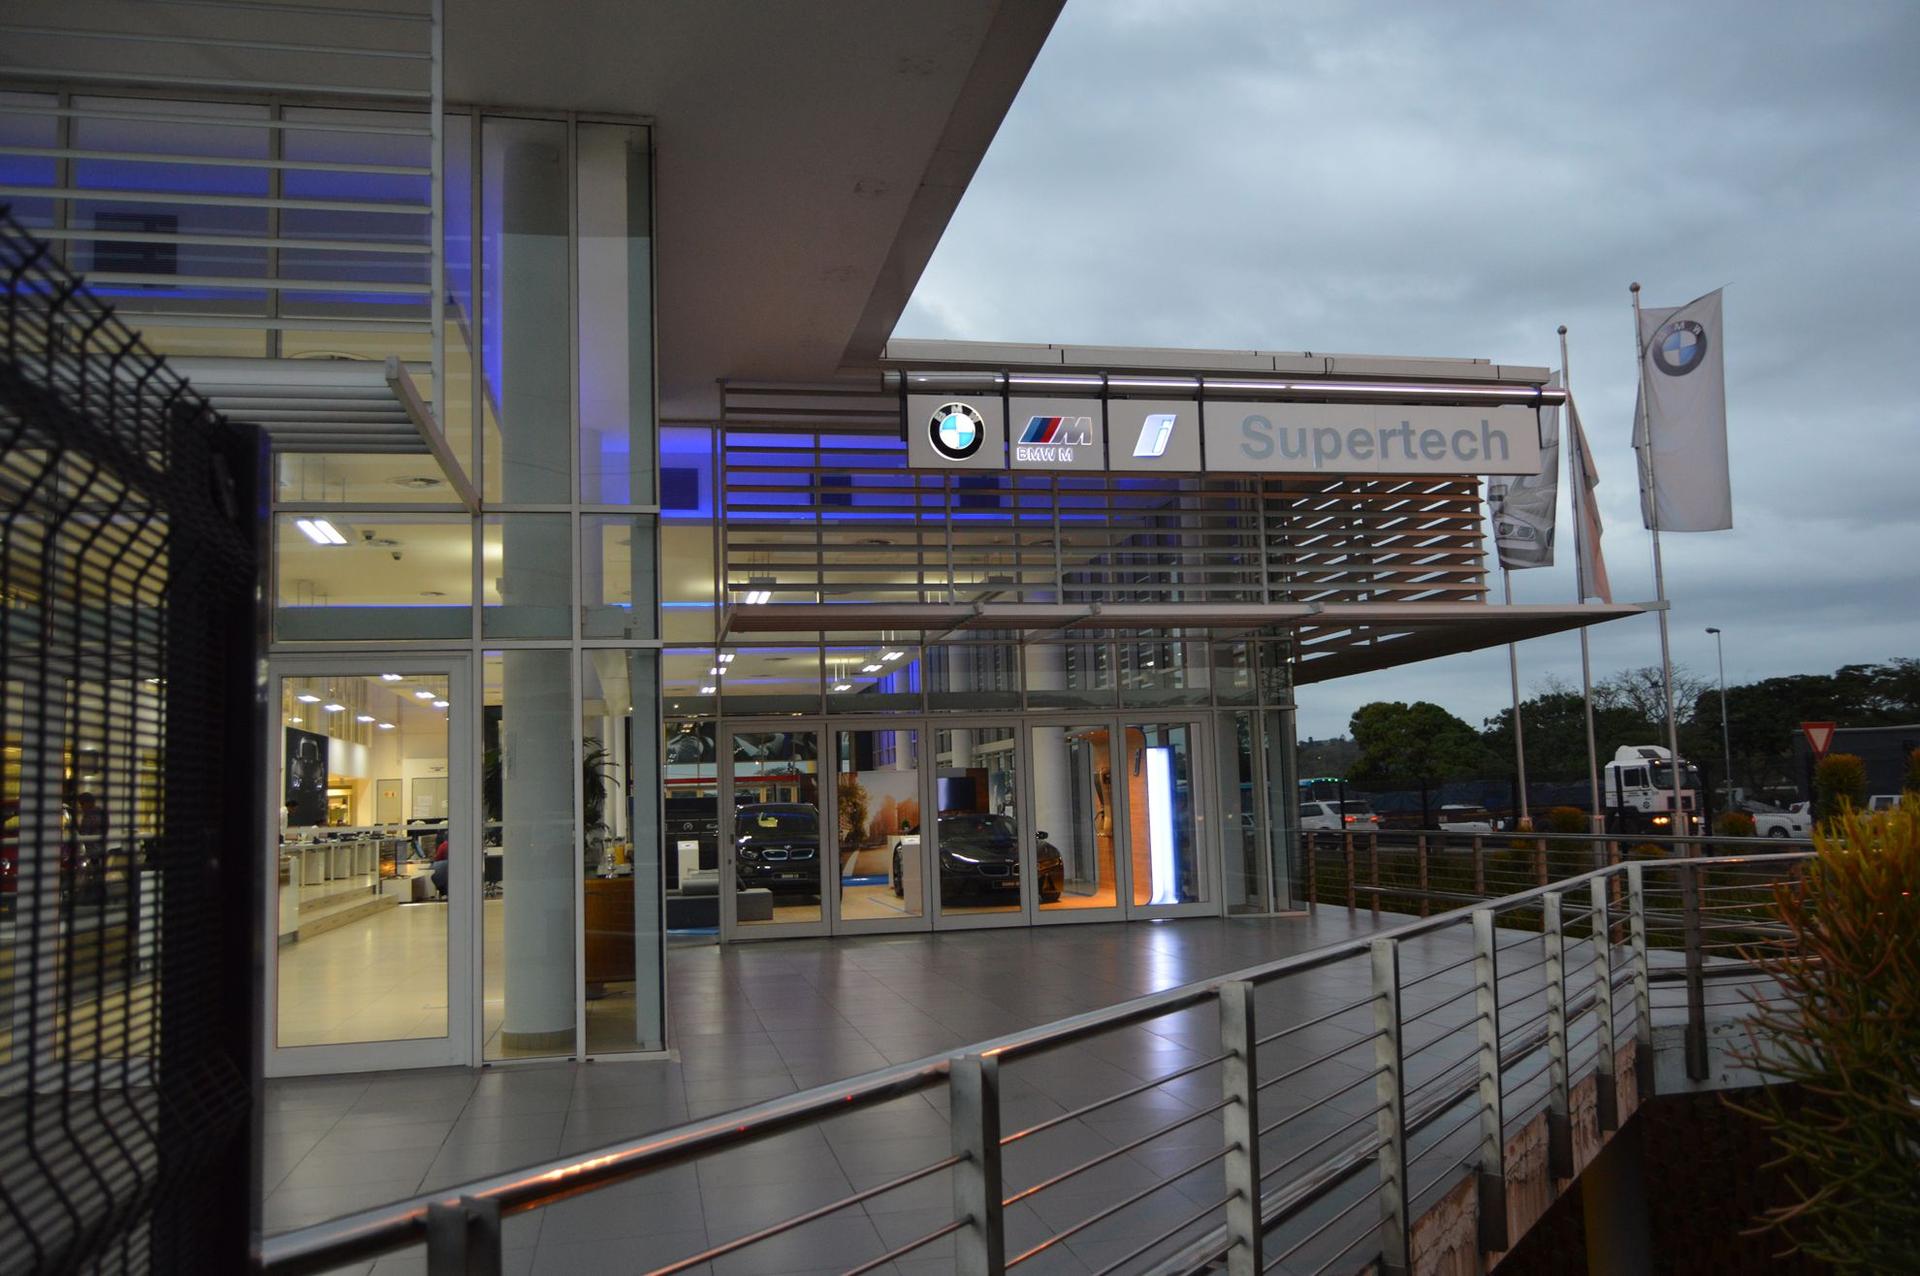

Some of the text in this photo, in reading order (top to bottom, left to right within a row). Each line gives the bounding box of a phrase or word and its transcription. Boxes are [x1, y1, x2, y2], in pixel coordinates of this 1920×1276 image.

[933, 403, 981, 423] BMW
[1240, 414, 1509, 468] Supertech
[1017, 447, 1073, 462] BMW M
